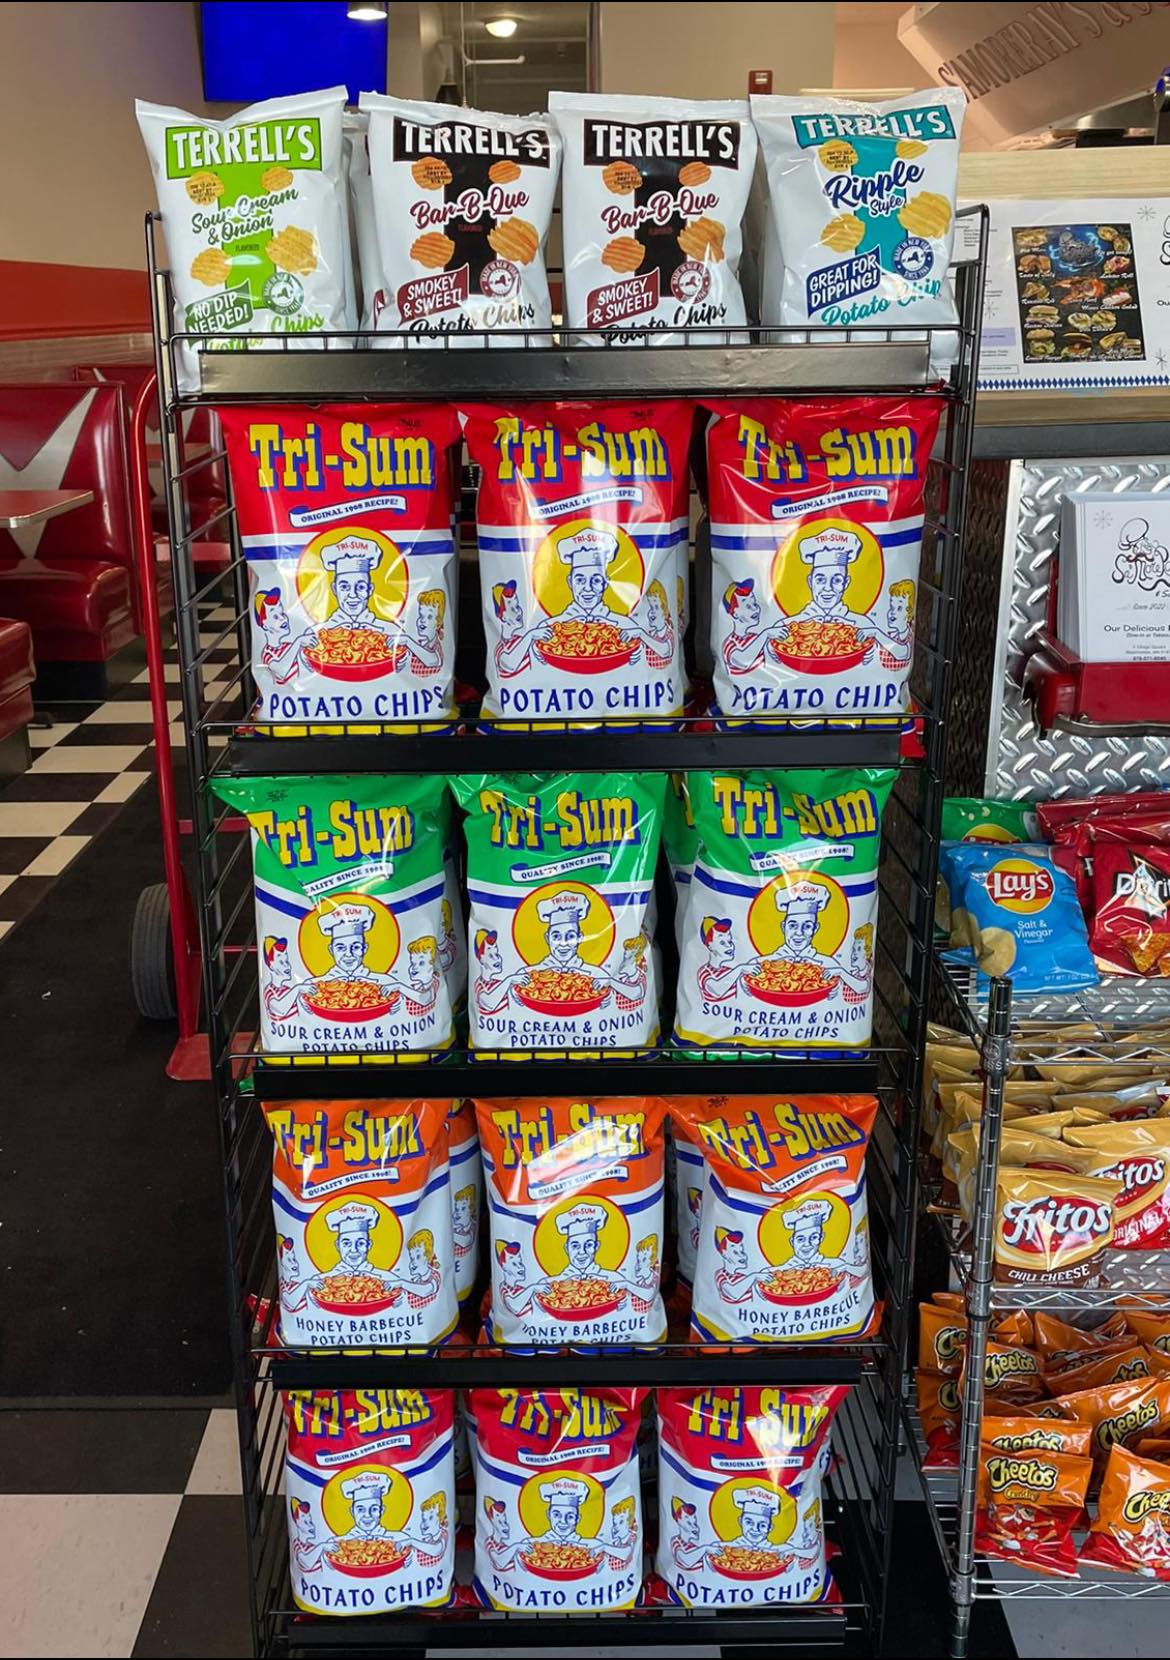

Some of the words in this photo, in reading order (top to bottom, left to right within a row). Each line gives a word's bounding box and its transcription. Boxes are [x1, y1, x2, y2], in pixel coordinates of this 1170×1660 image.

[401, 121, 545, 160] TERRELL'S
[801, 111, 948, 140] TERRELL'S
[173, 125, 315, 169] TERRELL'S
[592, 124, 735, 160] TERRELL'S
[823, 160, 925, 209] Ripple
[191, 207, 233, 235] Sour
[234, 185, 299, 217] Cream
[410, 187, 530, 230] Bar-B-Que
[601, 189, 720, 235] Bar-B-Que
[870, 195, 904, 216] Style
[207, 228, 219, 246] &
[220, 211, 274, 241] Onion
[809, 265, 850, 291] GREAT
[852, 253, 877, 277] FOR
[406, 273, 458, 302] SMOKEY
[598, 277, 648, 307] SMOKEY
[811, 268, 880, 308] DIPPING!
[193, 302, 211, 321] NO
[212, 291, 238, 316] DIP
[402, 303, 413, 318] &
[413, 288, 463, 316] SWEET!
[482, 302, 536, 329] Chips
[591, 308, 602, 325] &
[604, 293, 653, 320] SWEET!
[673, 302, 728, 328] Chips
[821, 295, 891, 327] Potato
[188, 303, 250, 334] NEEDED!
[269, 312, 325, 334] Chips
[249, 421, 433, 490] Tri-Sum
[494, 417, 673, 482] Tri-Sum
[738, 414, 918, 484] Tri-Sum
[300, 508, 344, 524] ORIGINAL
[364, 498, 399, 509] RECIPE!
[781, 498, 827, 516] ORIGINAL
[847, 488, 882, 499] RECIPE!
[335, 542, 370, 551] TRI-SUM
[814, 535, 850, 545] TRI-SUM
[1104, 624, 1121, 632] Our
[1123, 623, 1166, 632] Delicious
[269, 693, 363, 719] POTATO
[374, 685, 446, 718] CHIPS
[500, 687, 595, 713] POTATO
[605, 678, 675, 709] CHIPS
[731, 684, 825, 712] POTATO
[480, 791, 641, 851] Tri-Sum
[713, 777, 879, 842] Tri-Sum
[246, 800, 415, 868] Tri-Sum
[336, 868, 363, 883] SINCE
[560, 857, 586, 871] SINCE
[551, 896, 579, 905] TRI-SUM
[993, 870, 1050, 901] Lay's
[1014, 927, 1054, 941] Vinegar
[1017, 919, 1037, 929] Salt
[1038, 919, 1048, 928] &
[270, 1021, 308, 1040] SOUR
[313, 1025, 368, 1041] CREAM
[373, 1026, 384, 1039] &
[389, 1012, 436, 1037] ONION
[478, 1015, 518, 1034] SOUR
[522, 1020, 577, 1033] CREAM
[583, 1021, 593, 1034] &
[598, 1008, 645, 1032] ONION
[702, 1002, 743, 1023] SOUR
[748, 1010, 802, 1026] CREAM
[807, 1011, 818, 1025] &
[823, 1004, 867, 1024] ONION
[364, 1039, 410, 1051] CHIPS
[510, 1033, 566, 1048] POTATO
[572, 1033, 618, 1047] CHIPS
[732, 1025, 790, 1039] POTATO
[793, 1025, 840, 1040] CHIPS
[267, 1108, 425, 1169] Tri-Sum
[492, 1103, 648, 1169] Tri-Sum
[698, 1102, 866, 1171] Tri-Sum
[307, 1179, 344, 1197] QUALITY
[344, 1172, 370, 1184] SINCE
[796, 1164, 820, 1182] SINCE
[1002, 1197, 1113, 1244] Fritos
[1007, 1270, 1037, 1283] CHILI
[1039, 1262, 1091, 1282] CHEESE
[296, 1316, 345, 1333] HONEY
[349, 1311, 425, 1333] BARBECUE
[738, 1307, 789, 1325] HONEY
[793, 1290, 861, 1322] BARBECUE
[809, 1312, 851, 1332] CHIPS
[311, 1332, 364, 1346] POTATO
[369, 1329, 412, 1344] CHIPS
[521, 1322, 568, 1338] HONEY
[572, 1316, 646, 1337] BARBECUE
[288, 1390, 432, 1438] Tri-Sum
[1098, 1400, 1158, 1450] Cheetos
[324, 1451, 360, 1464] ORIGINAL
[719, 1460, 756, 1469] ORIGINAL
[987, 1456, 1057, 1488] Cheetos
[300, 1577, 376, 1608] POTATO
[383, 1568, 445, 1606] CHIPS
[492, 1574, 567, 1607] POTATO
[576, 1573, 636, 1607] CHIPS
[675, 1573, 755, 1605] POTATO
[763, 1567, 821, 1602] CHIPS
